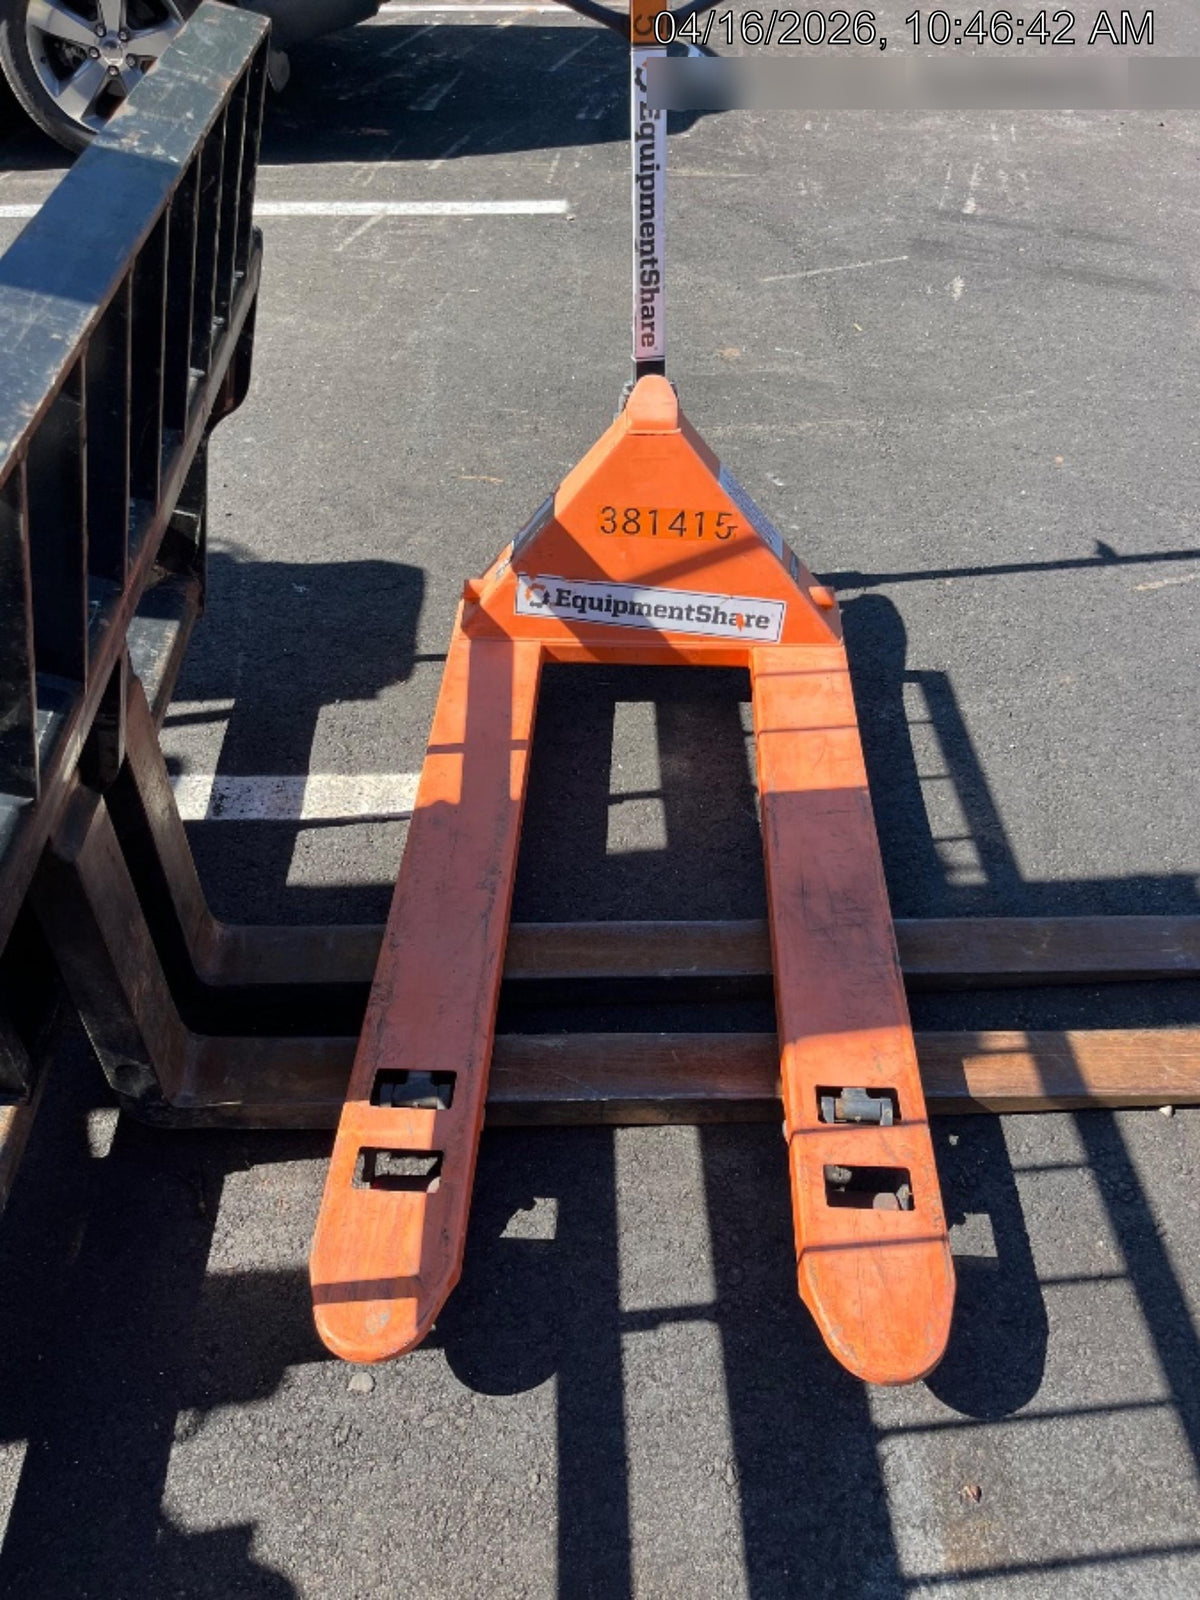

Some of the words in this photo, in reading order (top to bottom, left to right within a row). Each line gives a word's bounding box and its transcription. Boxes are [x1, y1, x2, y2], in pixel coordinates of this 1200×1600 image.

[634, 101, 661, 348] EquipmentShare
[599, 505, 738, 540] 381415
[554, 587, 771, 631] EquipmentShare
